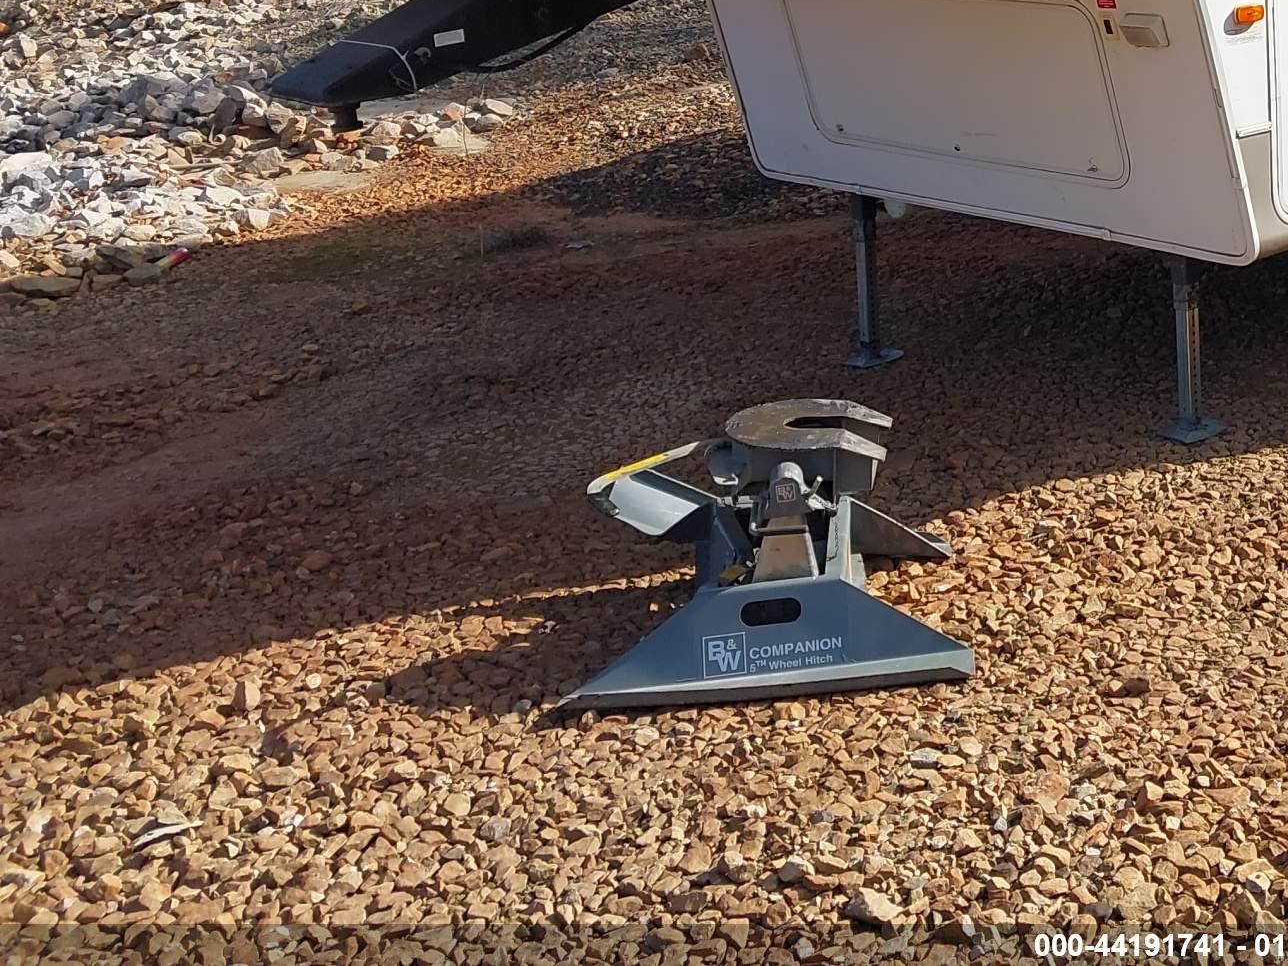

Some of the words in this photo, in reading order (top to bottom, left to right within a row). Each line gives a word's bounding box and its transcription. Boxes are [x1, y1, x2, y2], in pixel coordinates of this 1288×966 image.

[708, 638, 742, 672] B&W
[749, 636, 842, 659] COMPANION
[768, 657, 802, 670] Wheel
[805, 653, 833, 666] Hitch
